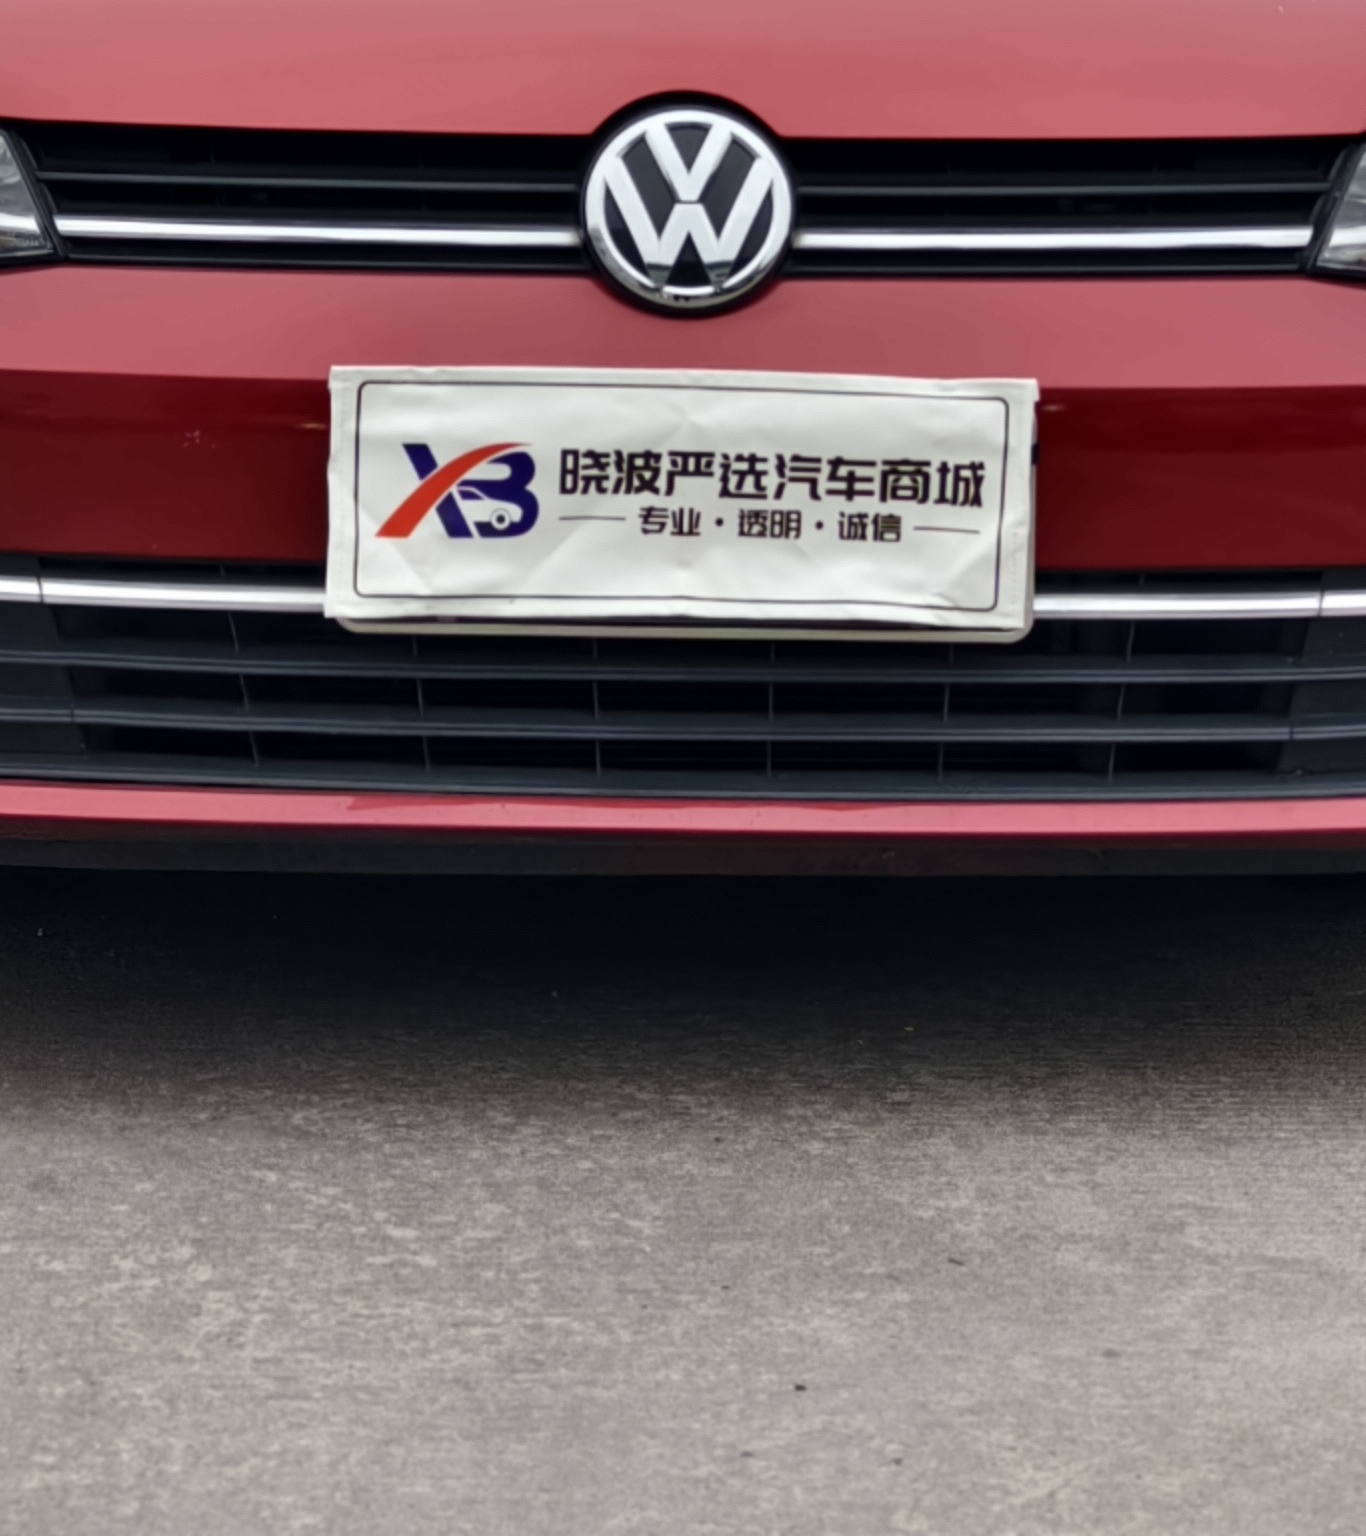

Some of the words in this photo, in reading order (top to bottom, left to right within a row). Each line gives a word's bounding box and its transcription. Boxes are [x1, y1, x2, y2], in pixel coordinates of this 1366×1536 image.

[558, 448, 986, 508] 晓波严选汽车商城
